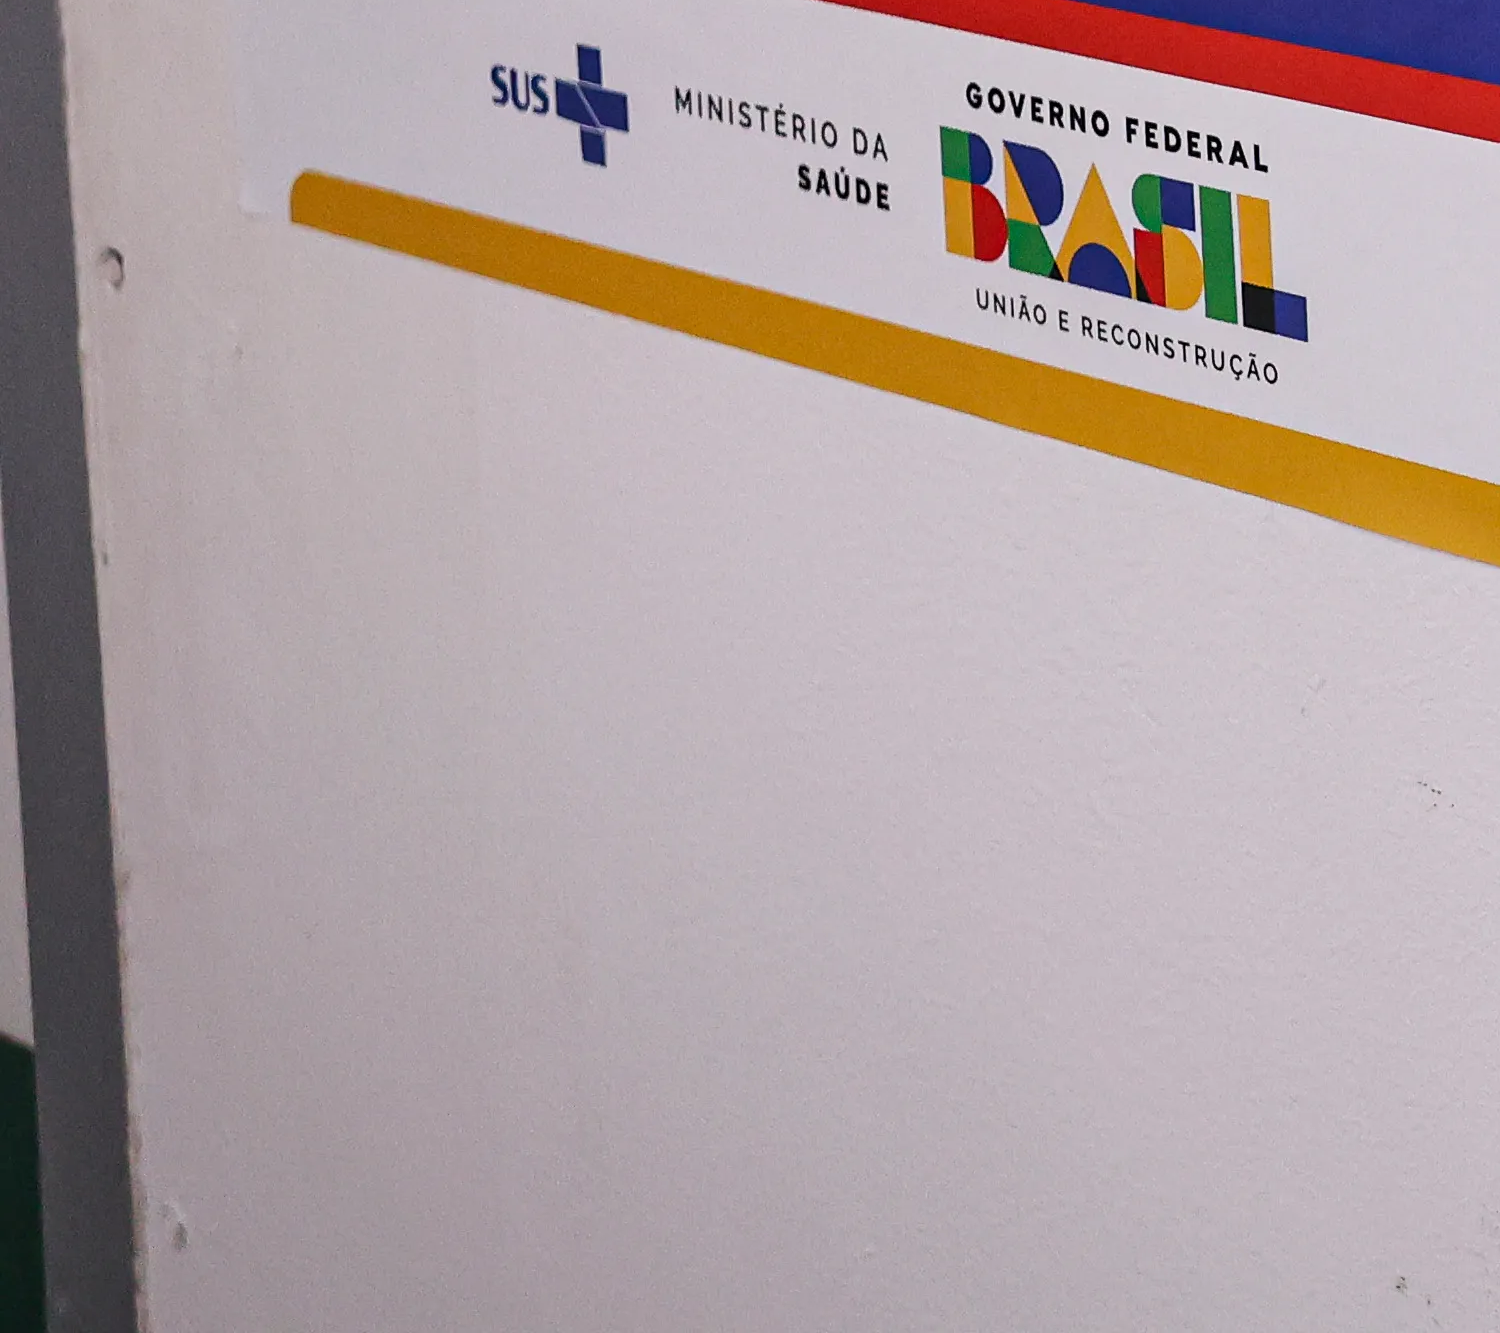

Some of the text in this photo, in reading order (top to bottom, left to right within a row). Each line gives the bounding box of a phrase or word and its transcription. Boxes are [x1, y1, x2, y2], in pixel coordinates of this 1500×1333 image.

[490, 64, 550, 115] SUS
[674, 85, 889, 163] MINISTÉRIO DA
[965, 81, 1269, 174] GOVERNO FEDERAL
[797, 163, 892, 212] SAÚDE
[939, 125, 1309, 343] BRASIL
[976, 287, 1279, 386] UNIÃO E RECONSTRUÇÃO
